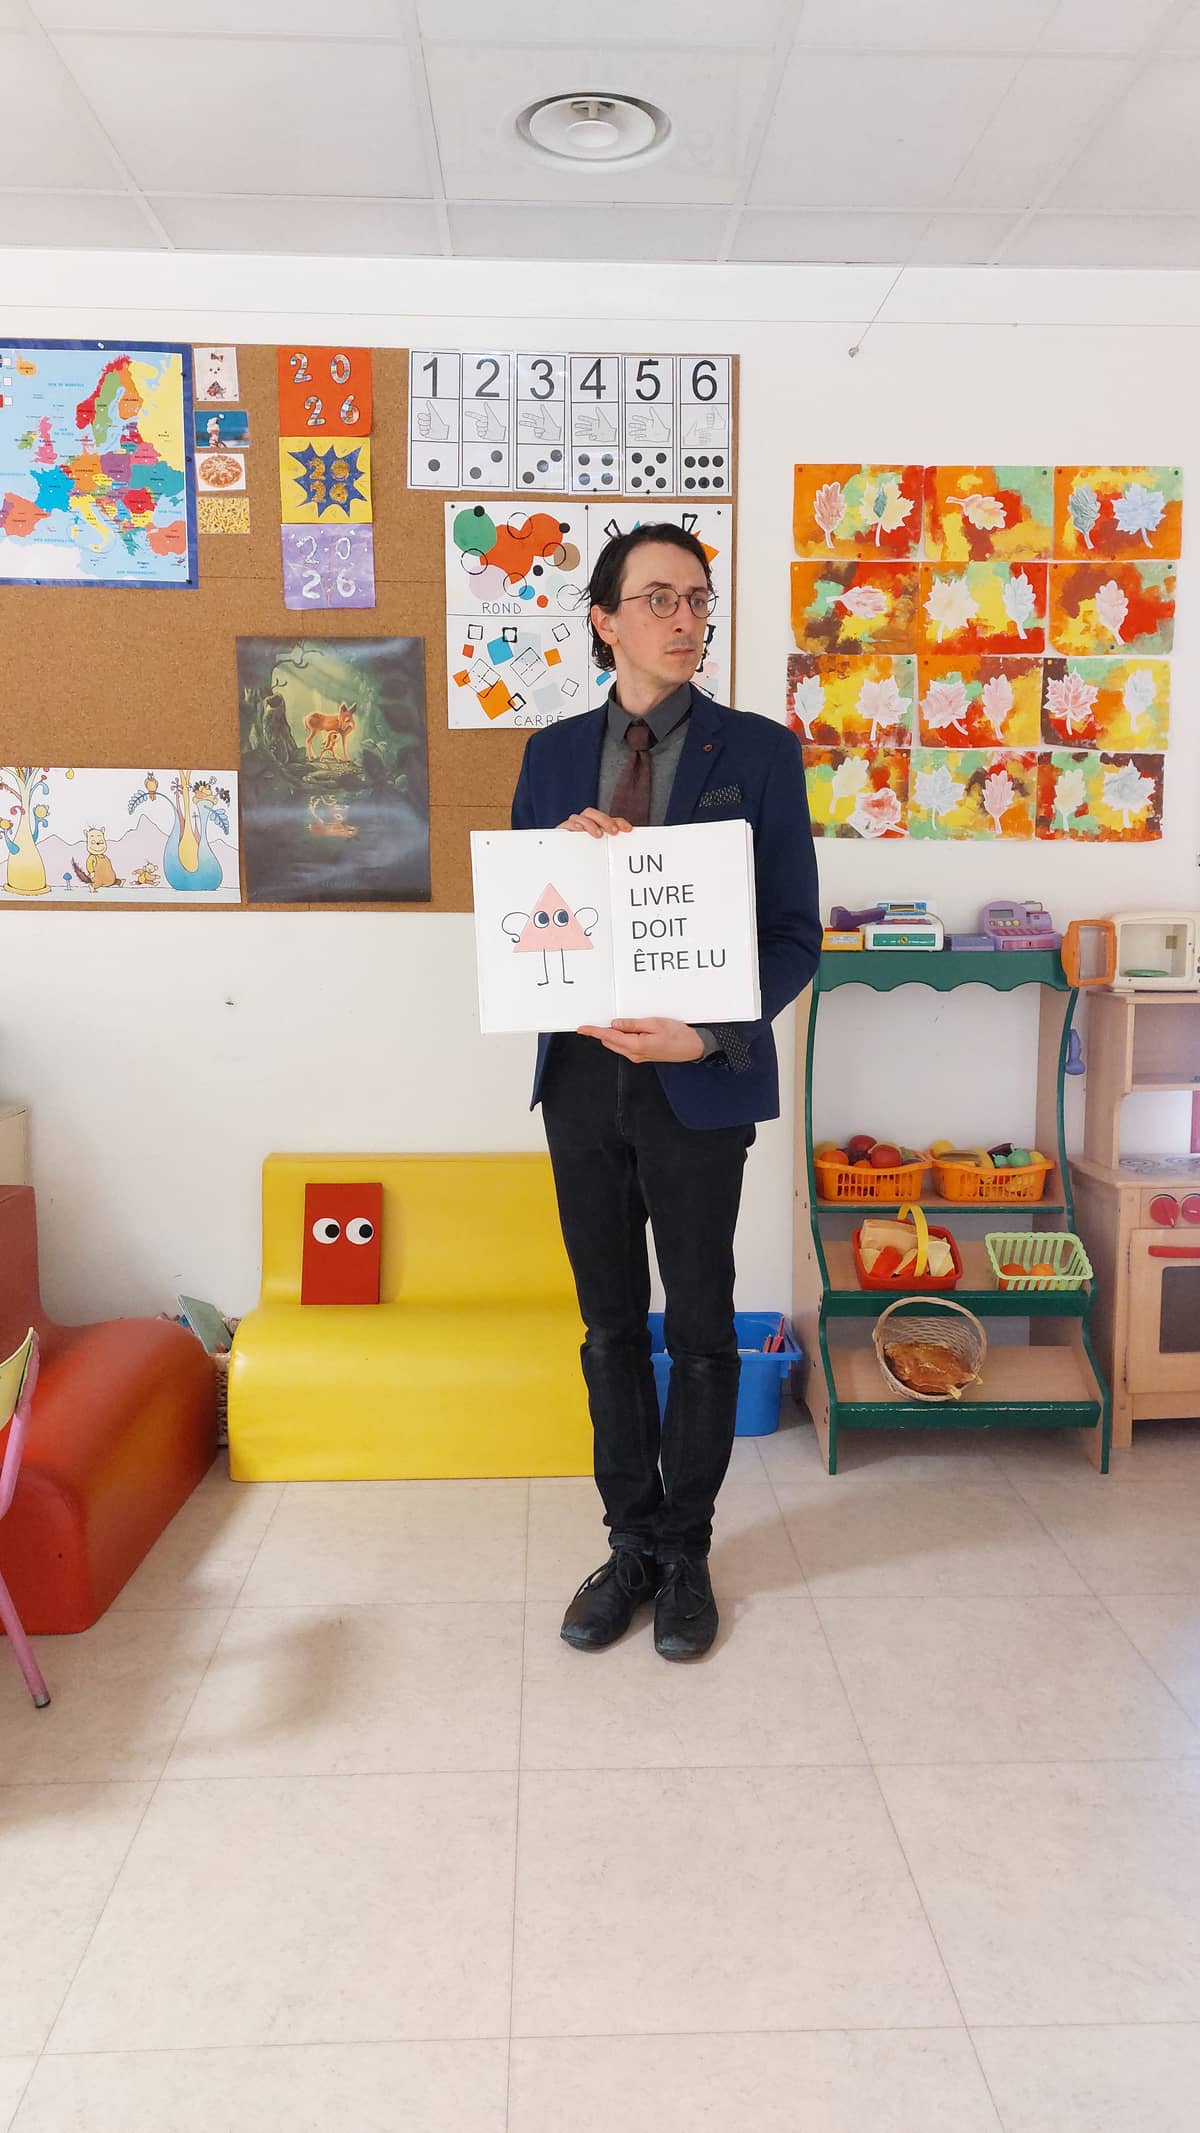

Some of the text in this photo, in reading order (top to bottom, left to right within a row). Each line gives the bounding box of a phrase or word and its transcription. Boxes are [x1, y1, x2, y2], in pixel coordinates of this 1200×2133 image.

[422, 357, 718, 401] 1 2 3 4 5 6
[482, 601, 522, 615] ROND
[628, 853, 663, 874] UN
[630, 884, 695, 907] LIVRE
[632, 918, 687, 940] DOIT
[634, 949, 726, 972] ÊTRE LU
